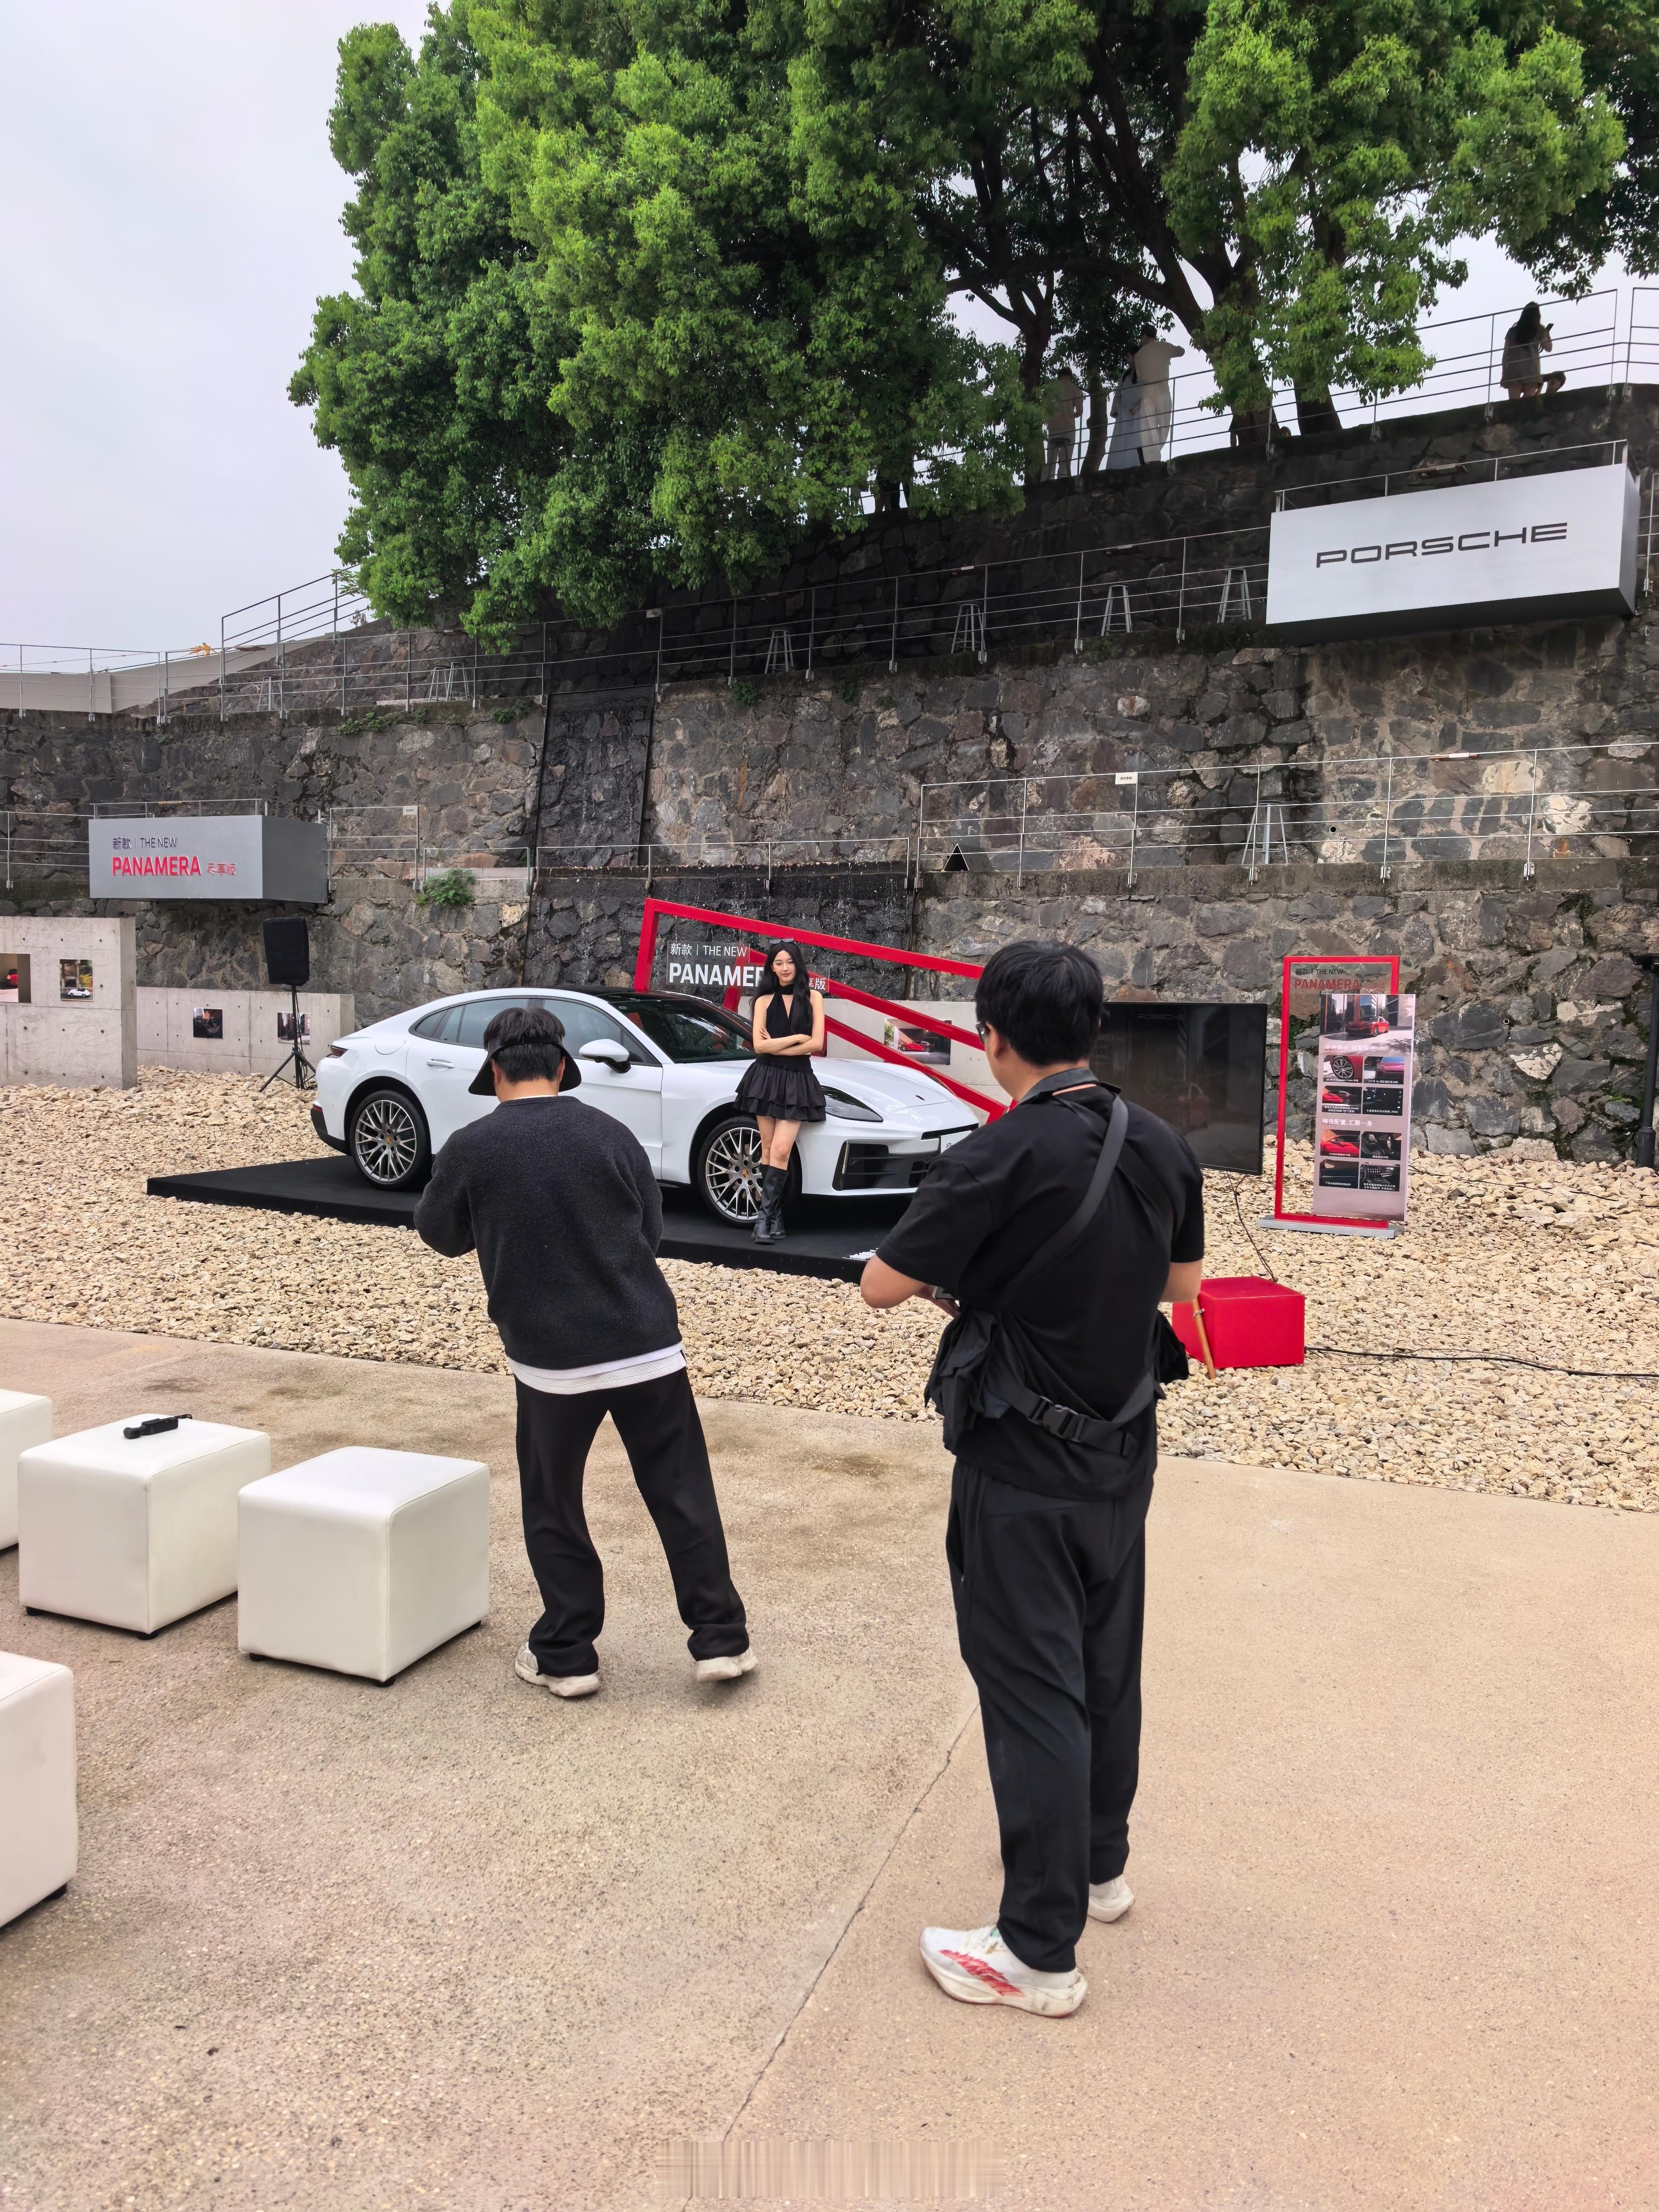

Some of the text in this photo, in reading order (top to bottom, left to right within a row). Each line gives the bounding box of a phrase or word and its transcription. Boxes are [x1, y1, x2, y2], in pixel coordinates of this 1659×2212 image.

[1316, 522, 1568, 568] PORSCHE
[112, 837, 178, 849] 新款 THE NEW
[112, 855, 202, 876] PANAMERA
[670, 943, 747, 957] 新款 THE NEW
[1294, 978, 1361, 990] PANAMERA
